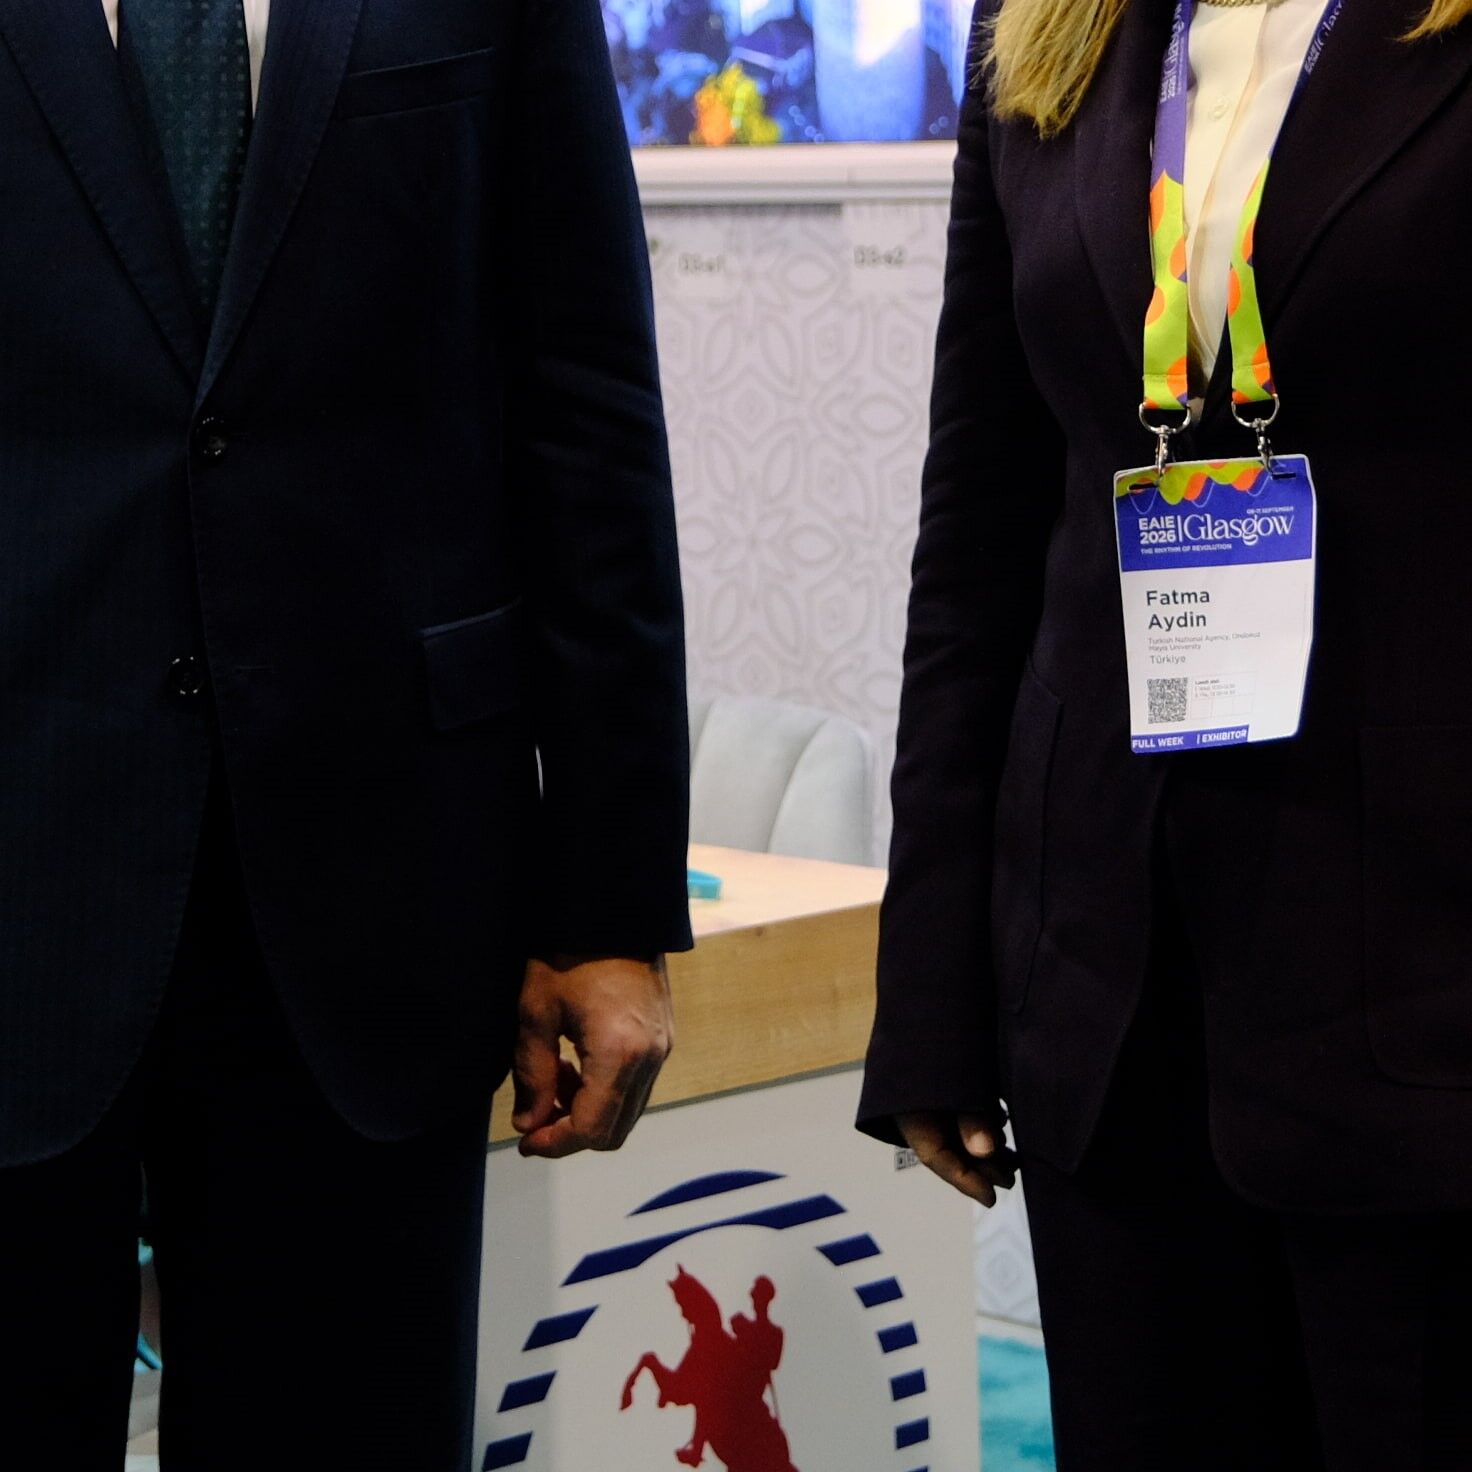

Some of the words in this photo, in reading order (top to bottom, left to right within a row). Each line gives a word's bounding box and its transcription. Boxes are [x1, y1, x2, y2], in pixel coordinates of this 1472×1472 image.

[1138, 515, 1175, 530] EAIE
[1183, 513, 1294, 545] Glasgow
[1140, 530, 1176, 545] 2026
[1191, 543, 1232, 551] REVOLUTION
[1147, 590, 1210, 606] Fatma
[1148, 611, 1207, 632] Aydin
[1175, 635, 1203, 643] National
[1150, 654, 1186, 664] Türkiye
[1132, 738, 1156, 748] FULL
[1158, 736, 1184, 747] WEEK
[1202, 729, 1247, 742] EXHIBITOR
